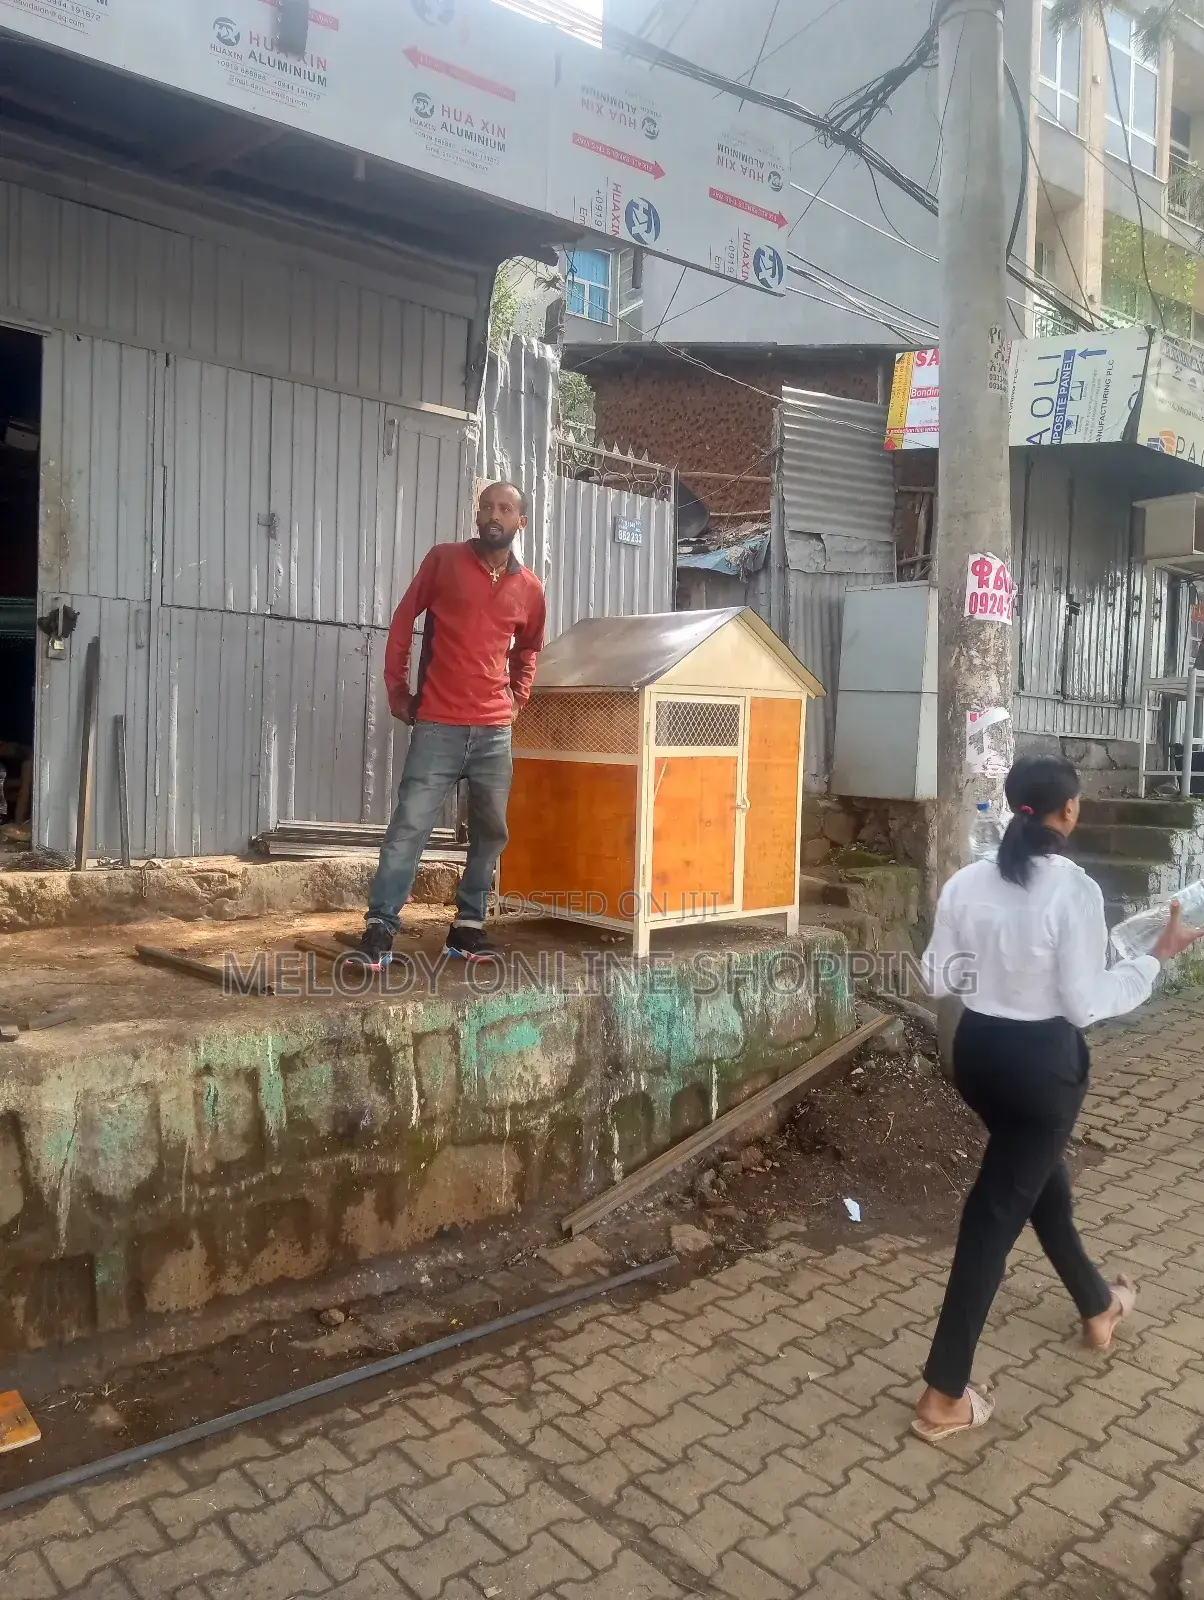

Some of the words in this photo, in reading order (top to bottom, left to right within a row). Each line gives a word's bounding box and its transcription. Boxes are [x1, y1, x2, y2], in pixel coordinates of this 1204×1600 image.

[210, 43, 243, 61] HUAXIN
[248, 49, 327, 87] ALUMINIUM
[581, 83, 637, 114] ALUMINIUM
[581, 97, 604, 116] XIN
[441, 104, 474, 127] HUA
[481, 119, 506, 139] XIN
[609, 108, 636, 130] HUA
[440, 121, 506, 152] ALUMINIUM
[717, 142, 764, 170] ALUMINIUM
[717, 154, 736, 172] XIN
[740, 164, 764, 184] HUA
[594, 188, 603, 227] +0919
[1060, 355, 1075, 394] PANEL
[1107, 359, 1115, 376] PLC
[1175, 435, 1204, 468] PA
